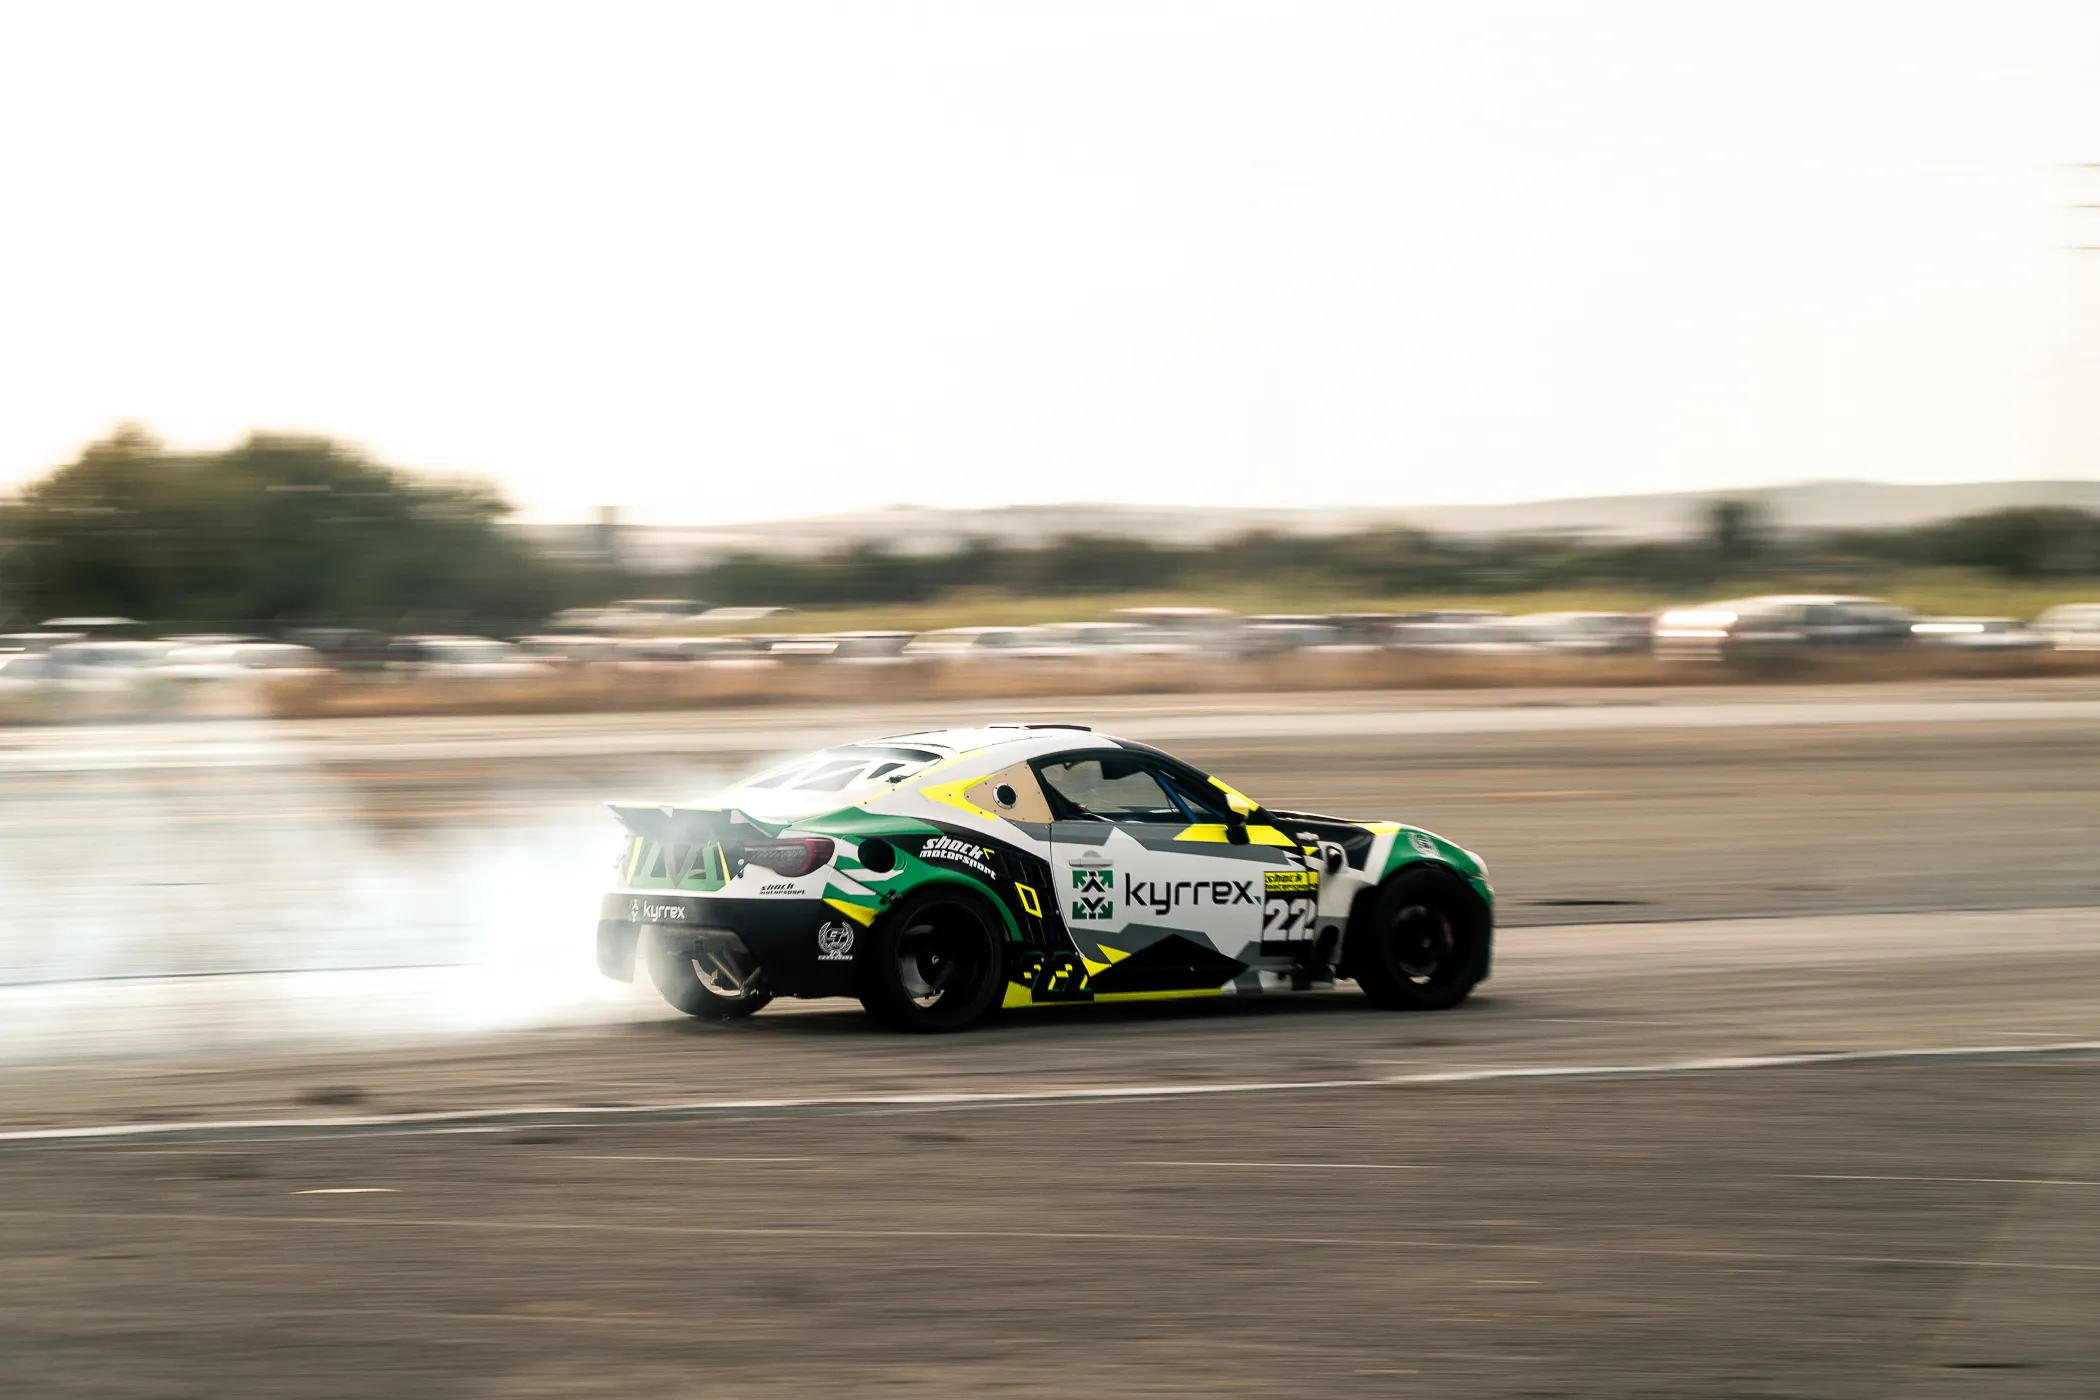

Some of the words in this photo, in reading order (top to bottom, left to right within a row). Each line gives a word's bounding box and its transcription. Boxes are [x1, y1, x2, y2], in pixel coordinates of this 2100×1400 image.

[923, 836, 984, 859] shock
[919, 849, 997, 881] motorsport
[1125, 872, 1255, 916] kyrrex
[643, 900, 686, 922] kyrrex
[1263, 898, 1317, 941] 22
